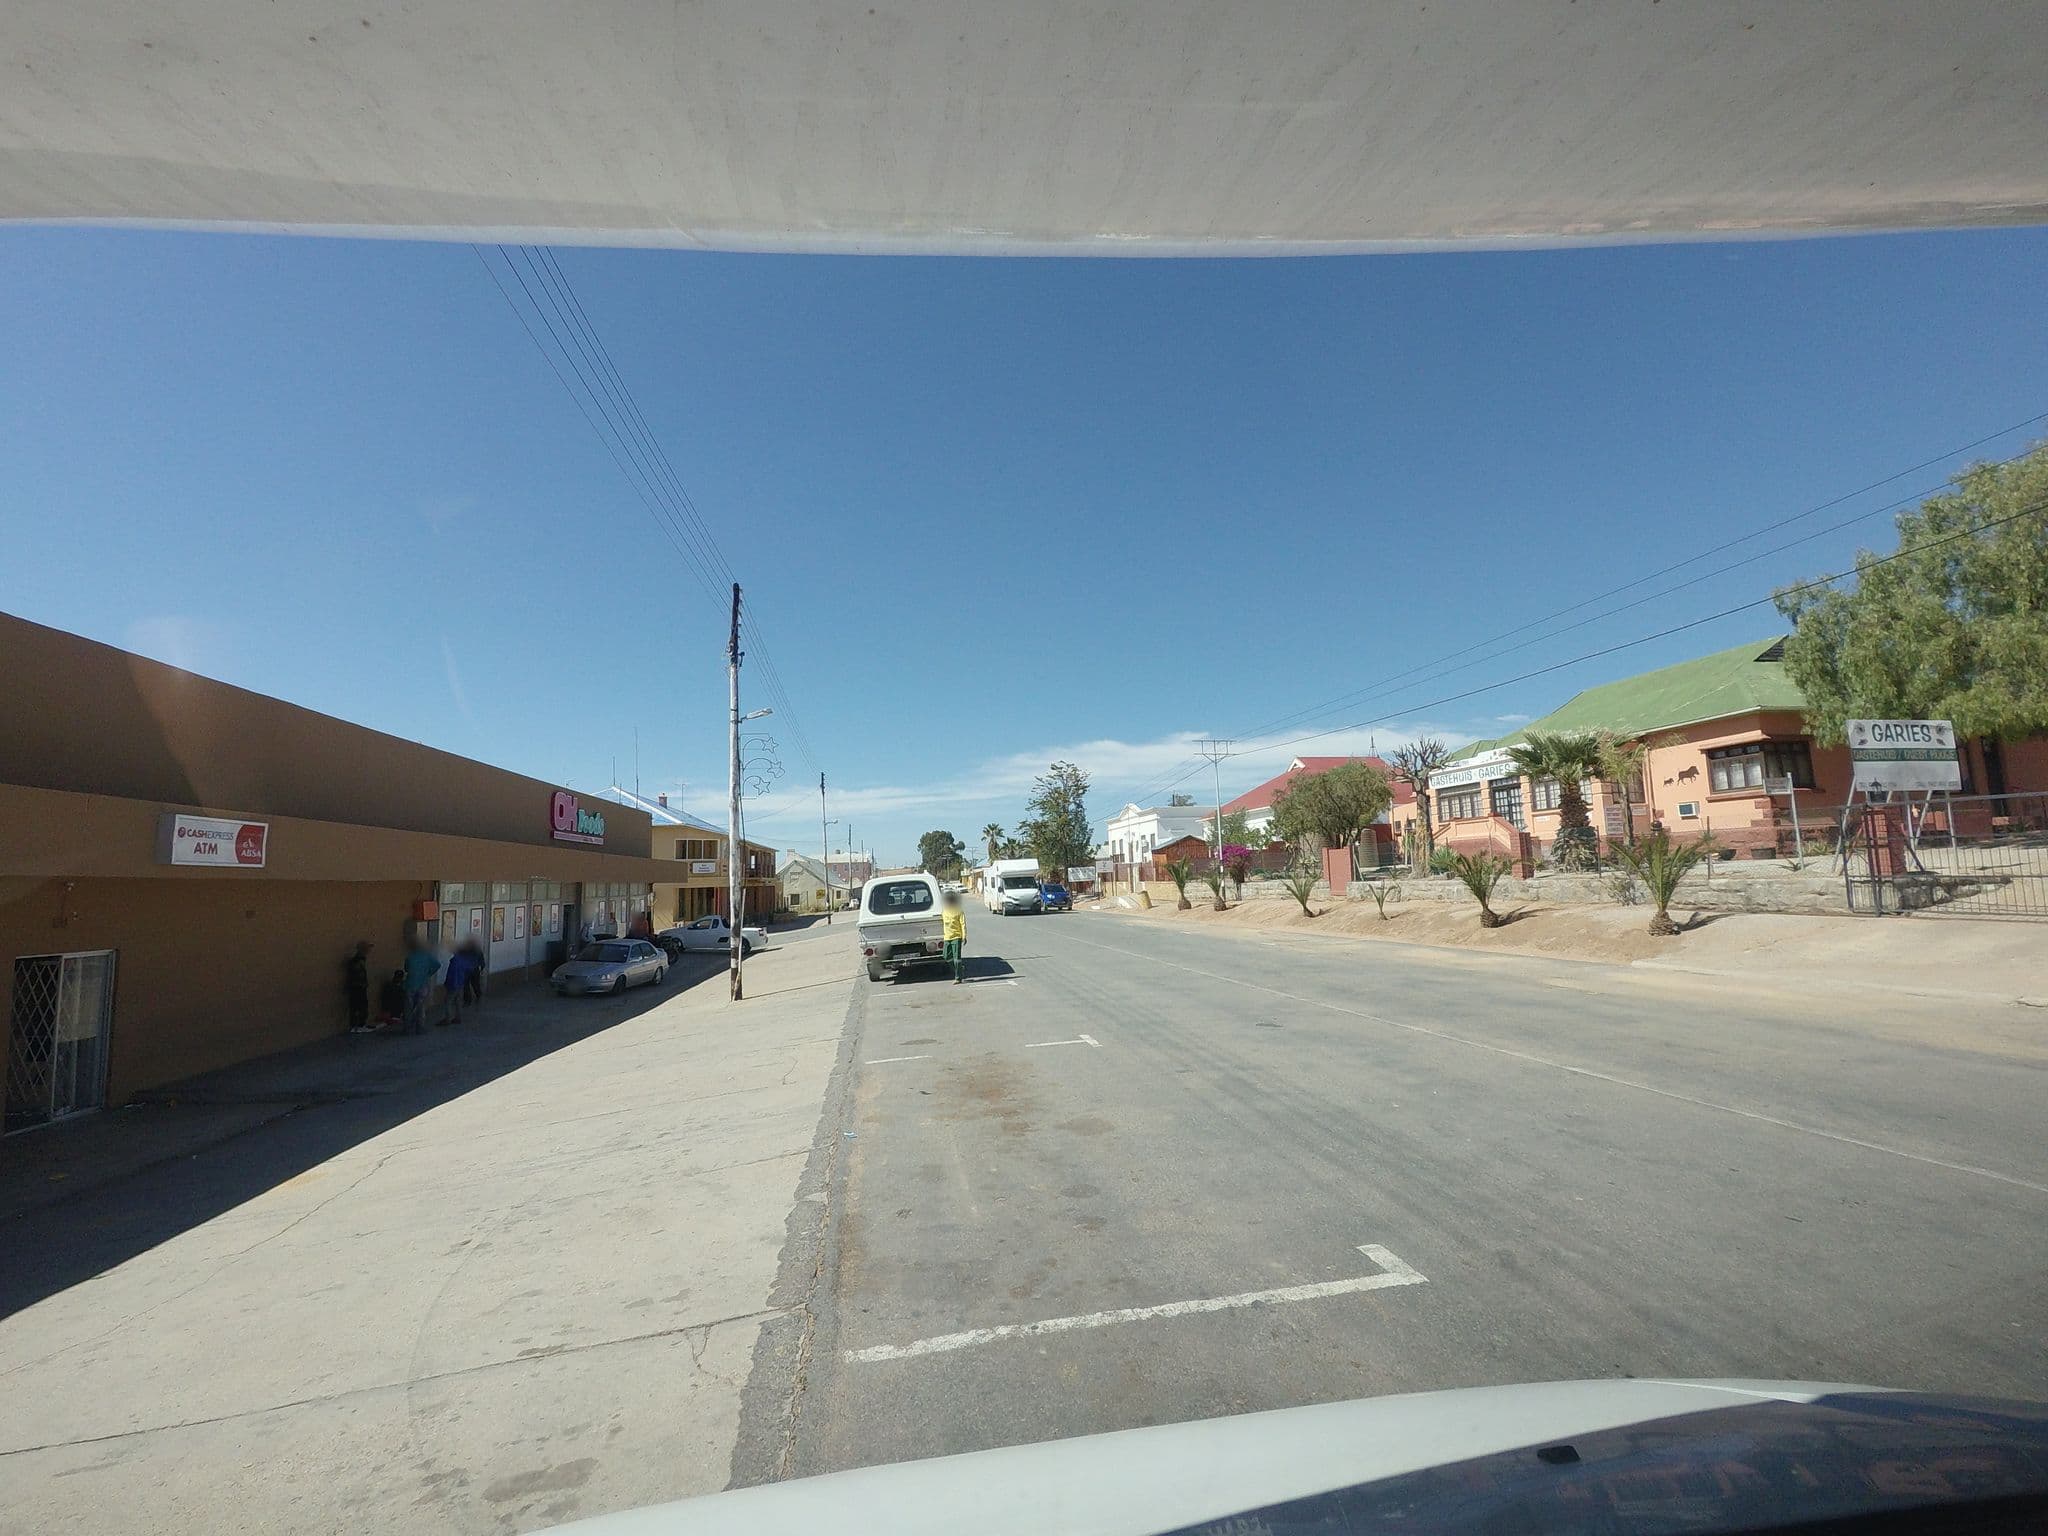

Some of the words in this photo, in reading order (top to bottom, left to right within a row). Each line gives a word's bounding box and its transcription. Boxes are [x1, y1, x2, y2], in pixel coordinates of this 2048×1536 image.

[1871, 723, 1932, 743] GARIES
[1430, 770, 1473, 787] GASTEHUIS
[1478, 763, 1511, 779] GARIES
[193, 841, 218, 855] ATM
